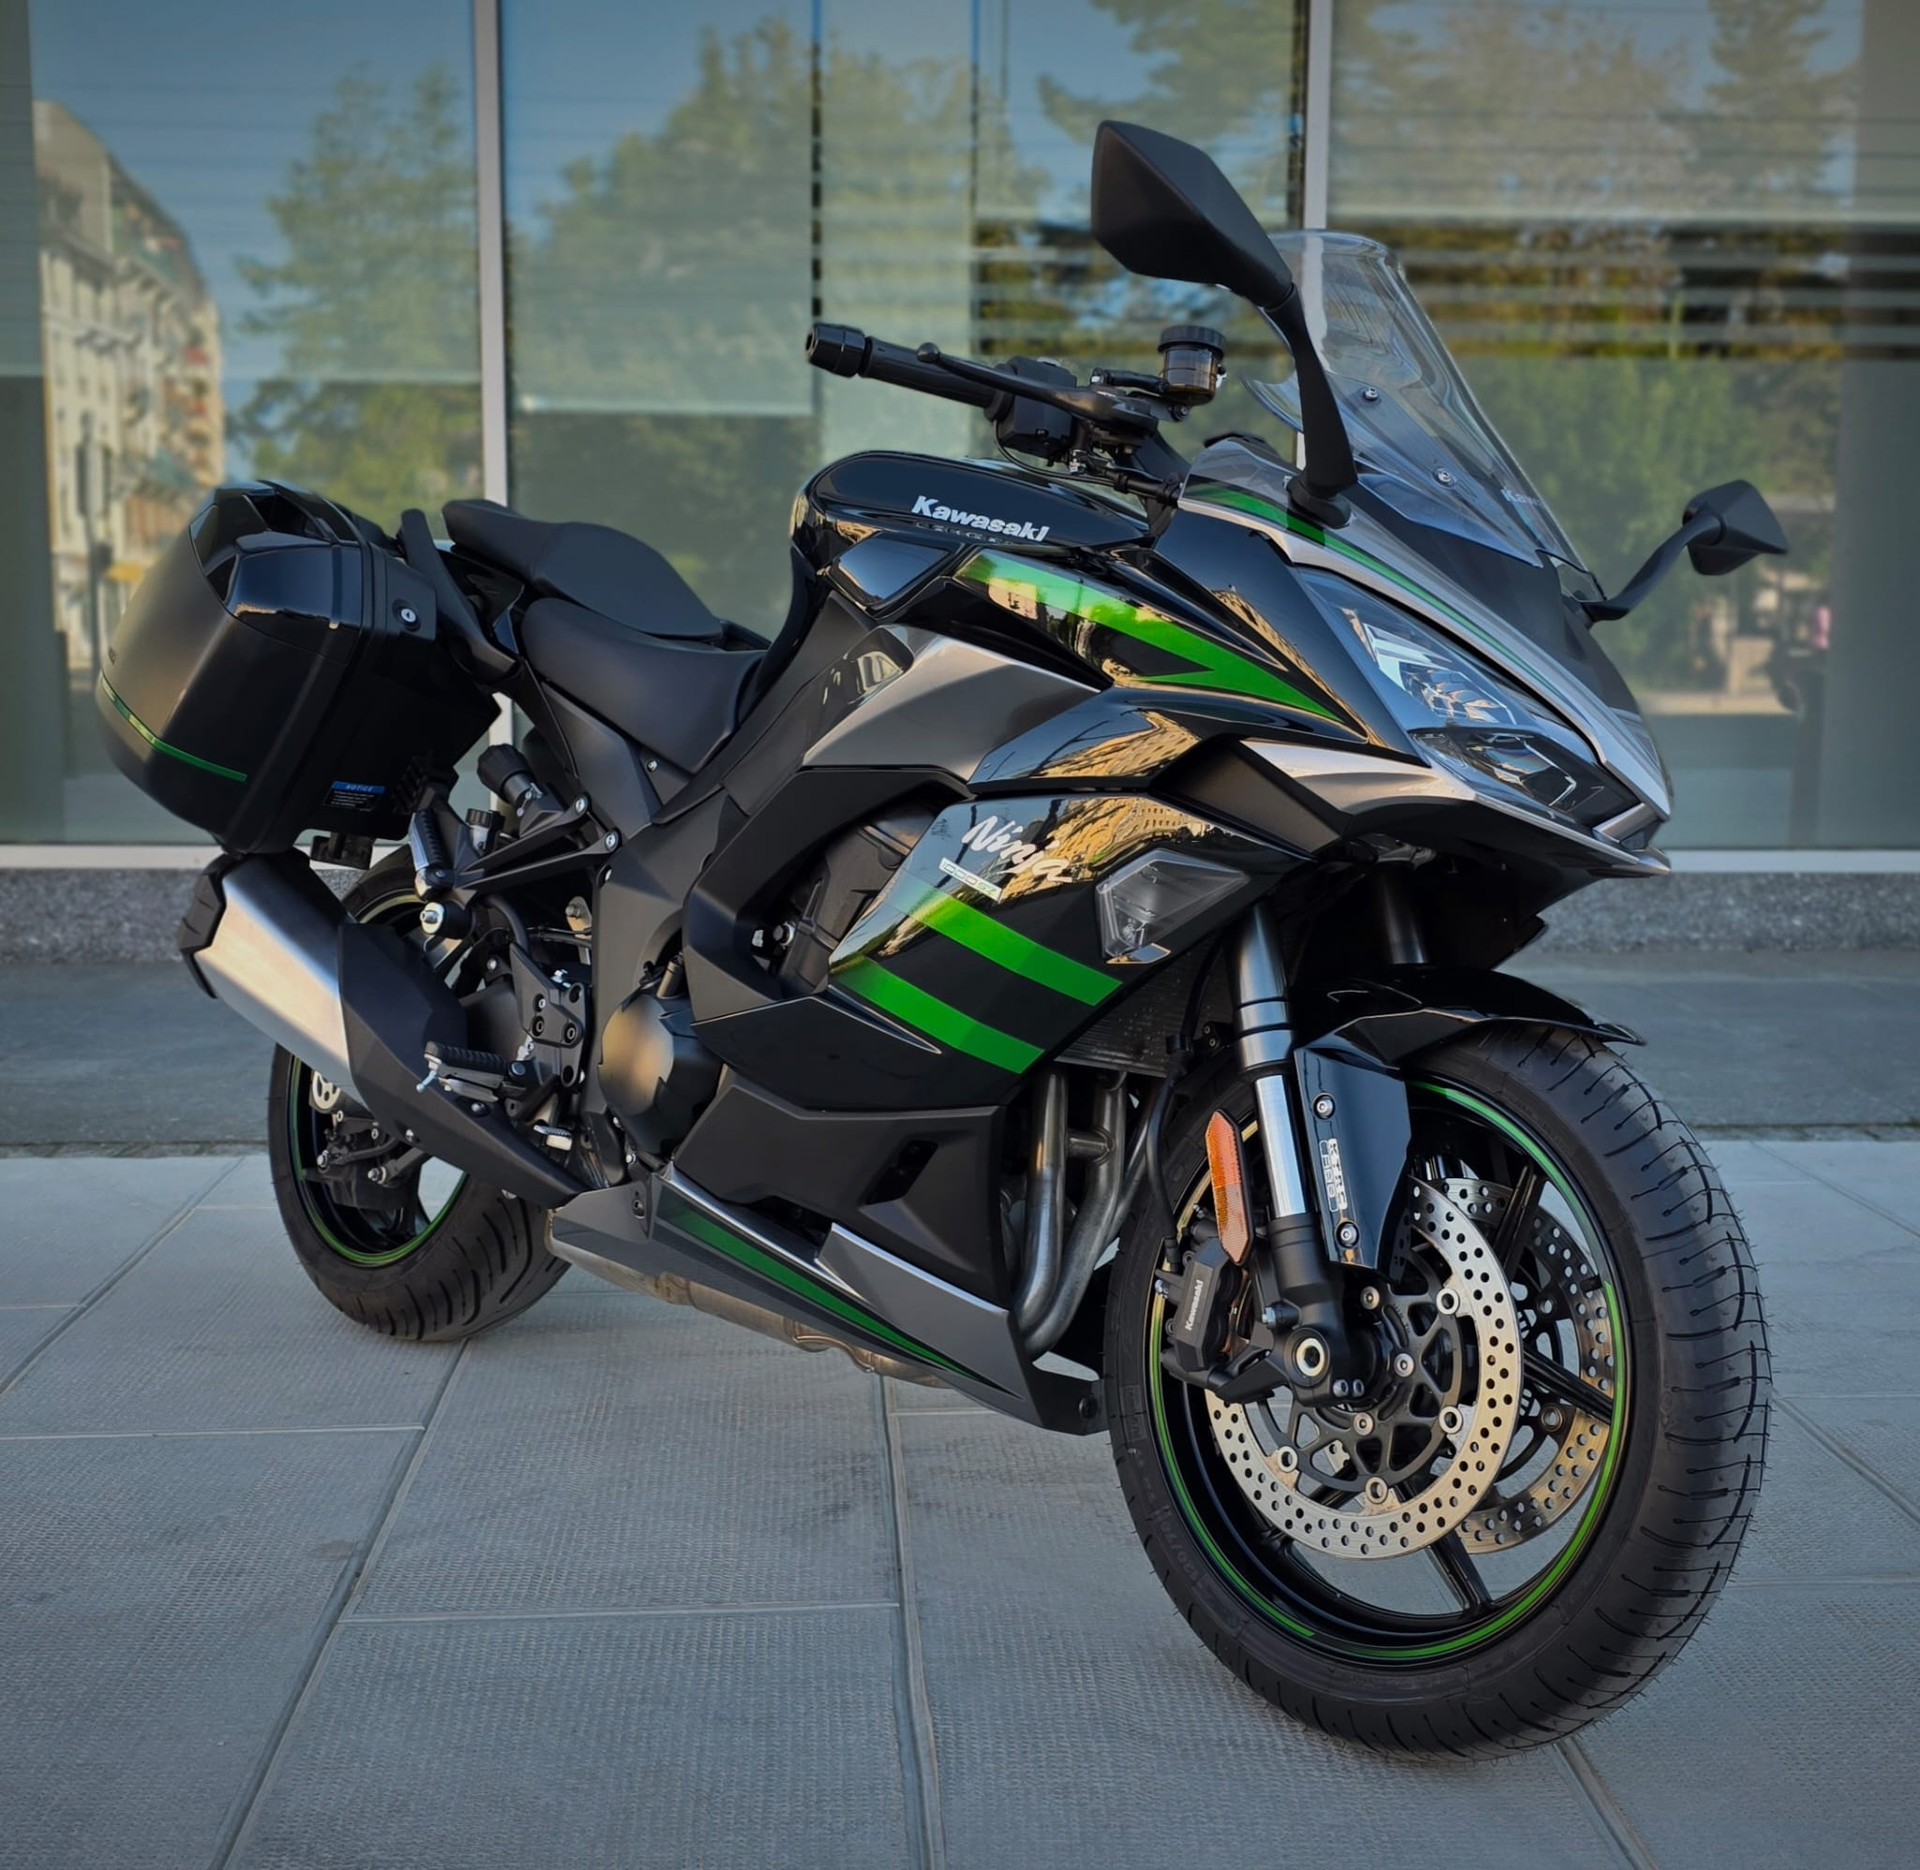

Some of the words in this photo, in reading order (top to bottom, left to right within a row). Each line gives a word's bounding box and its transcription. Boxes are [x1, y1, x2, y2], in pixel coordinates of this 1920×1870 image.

[911, 495, 1050, 542] Kawasaki
[961, 815, 1073, 883] Ninja
[1184, 1279, 1204, 1331] Kawasaki
